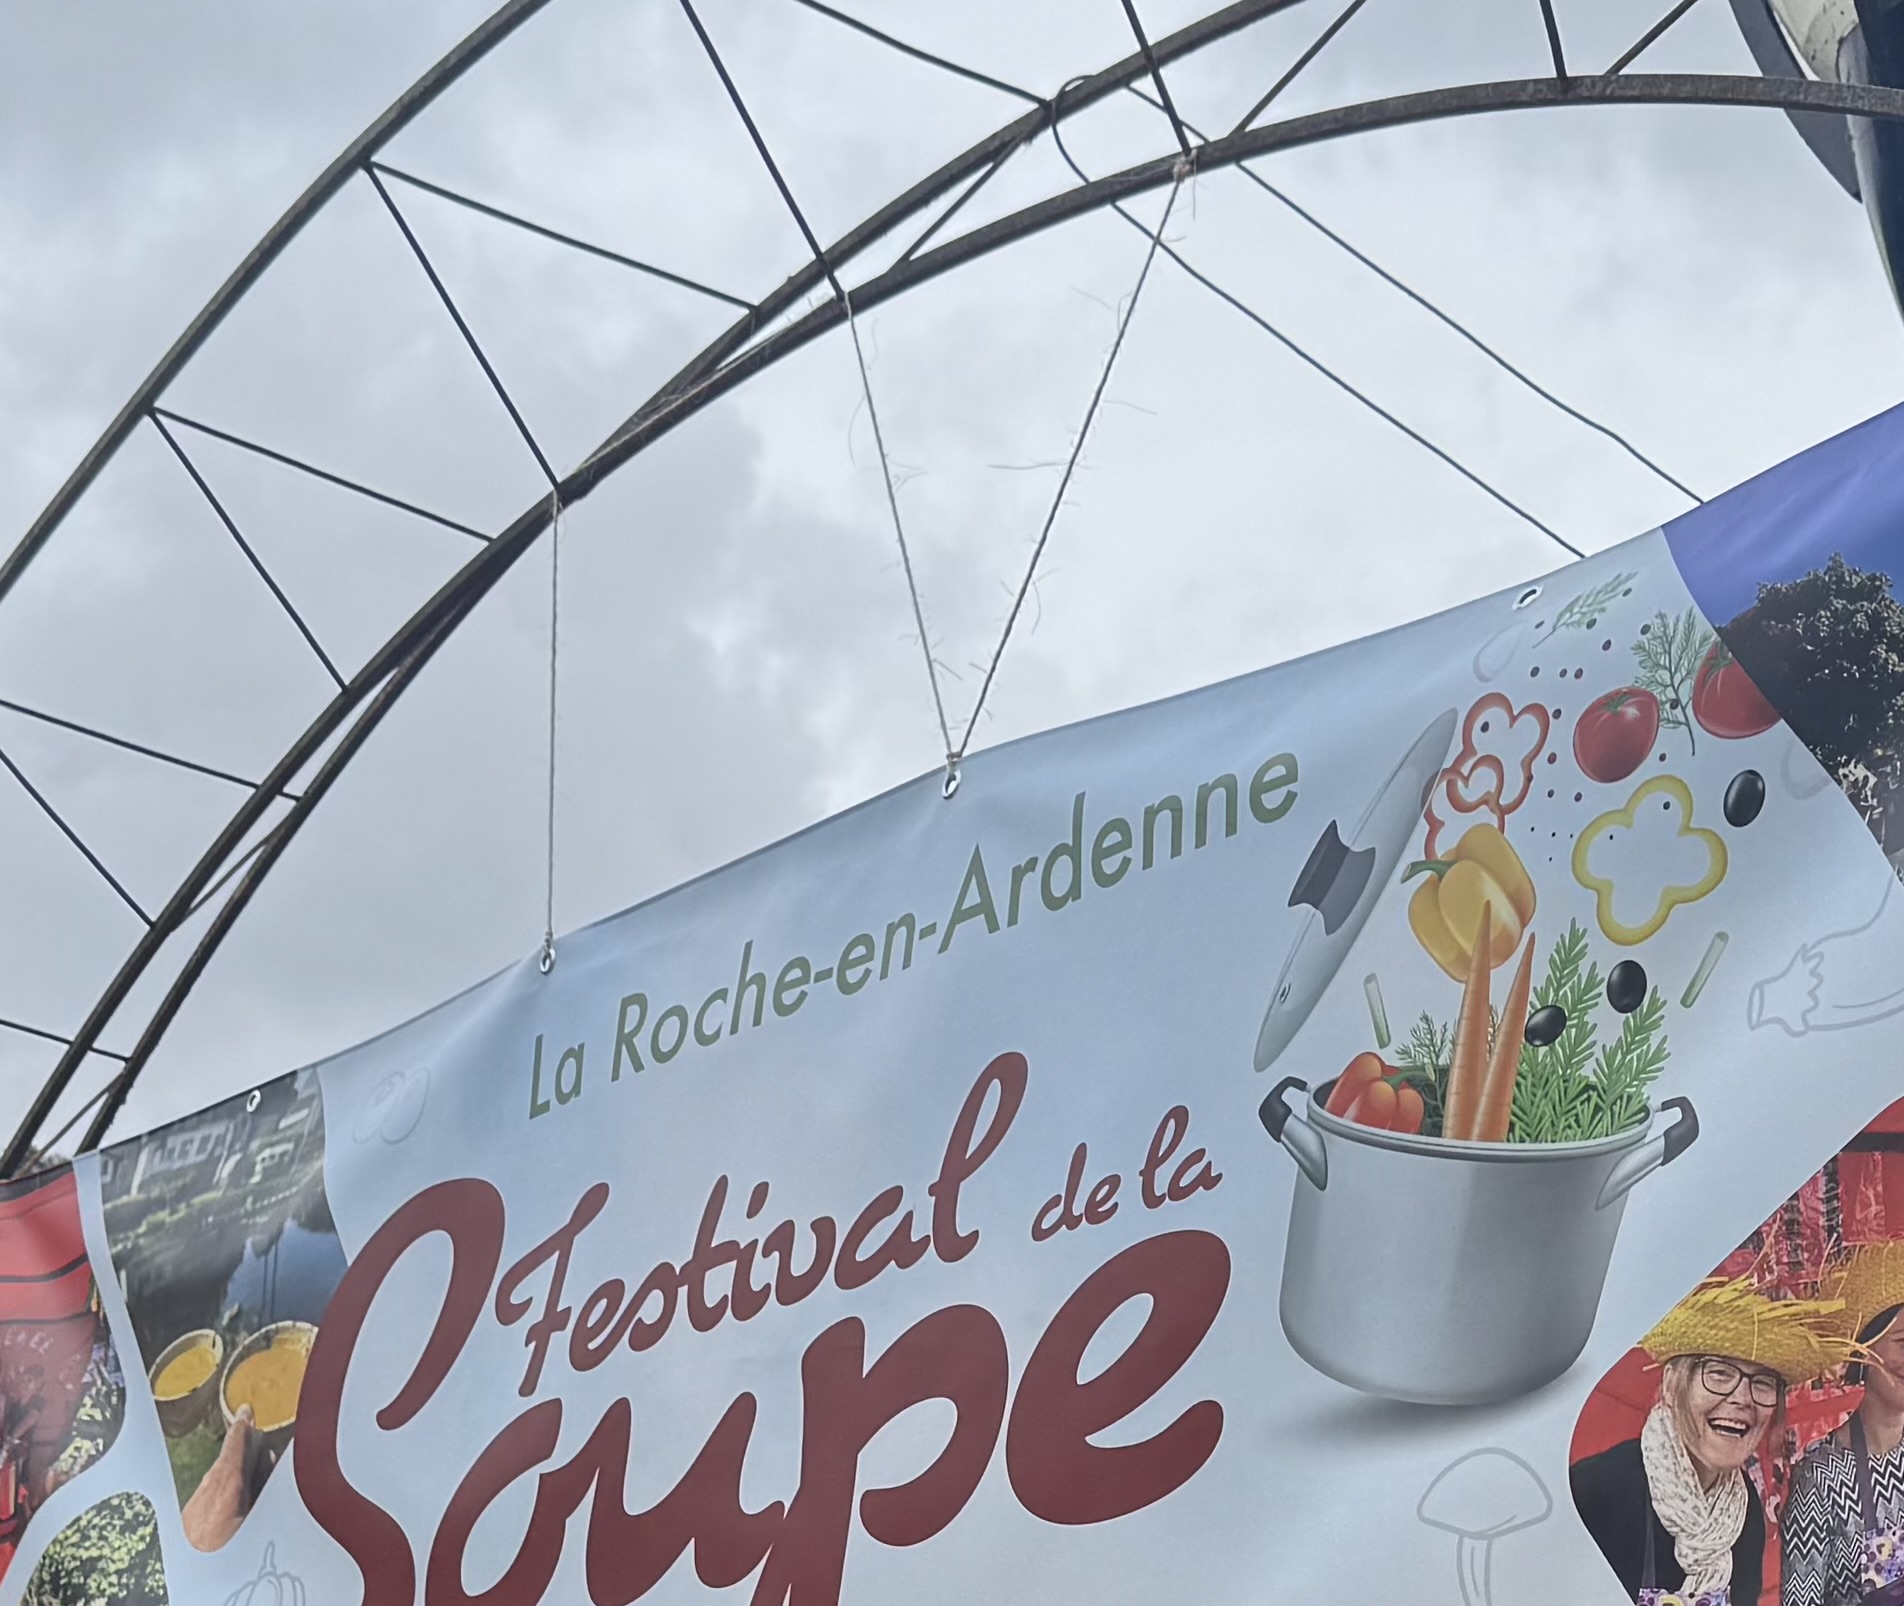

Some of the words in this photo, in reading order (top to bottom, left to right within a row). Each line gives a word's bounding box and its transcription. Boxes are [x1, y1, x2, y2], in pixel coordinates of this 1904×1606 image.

[529, 1034, 585, 1120] La
[610, 753, 1300, 1083] Roche-en-Ardenne
[496, 1051, 1029, 1398] Festival
[1030, 1142, 1121, 1243] de
[1140, 1104, 1224, 1210] la
